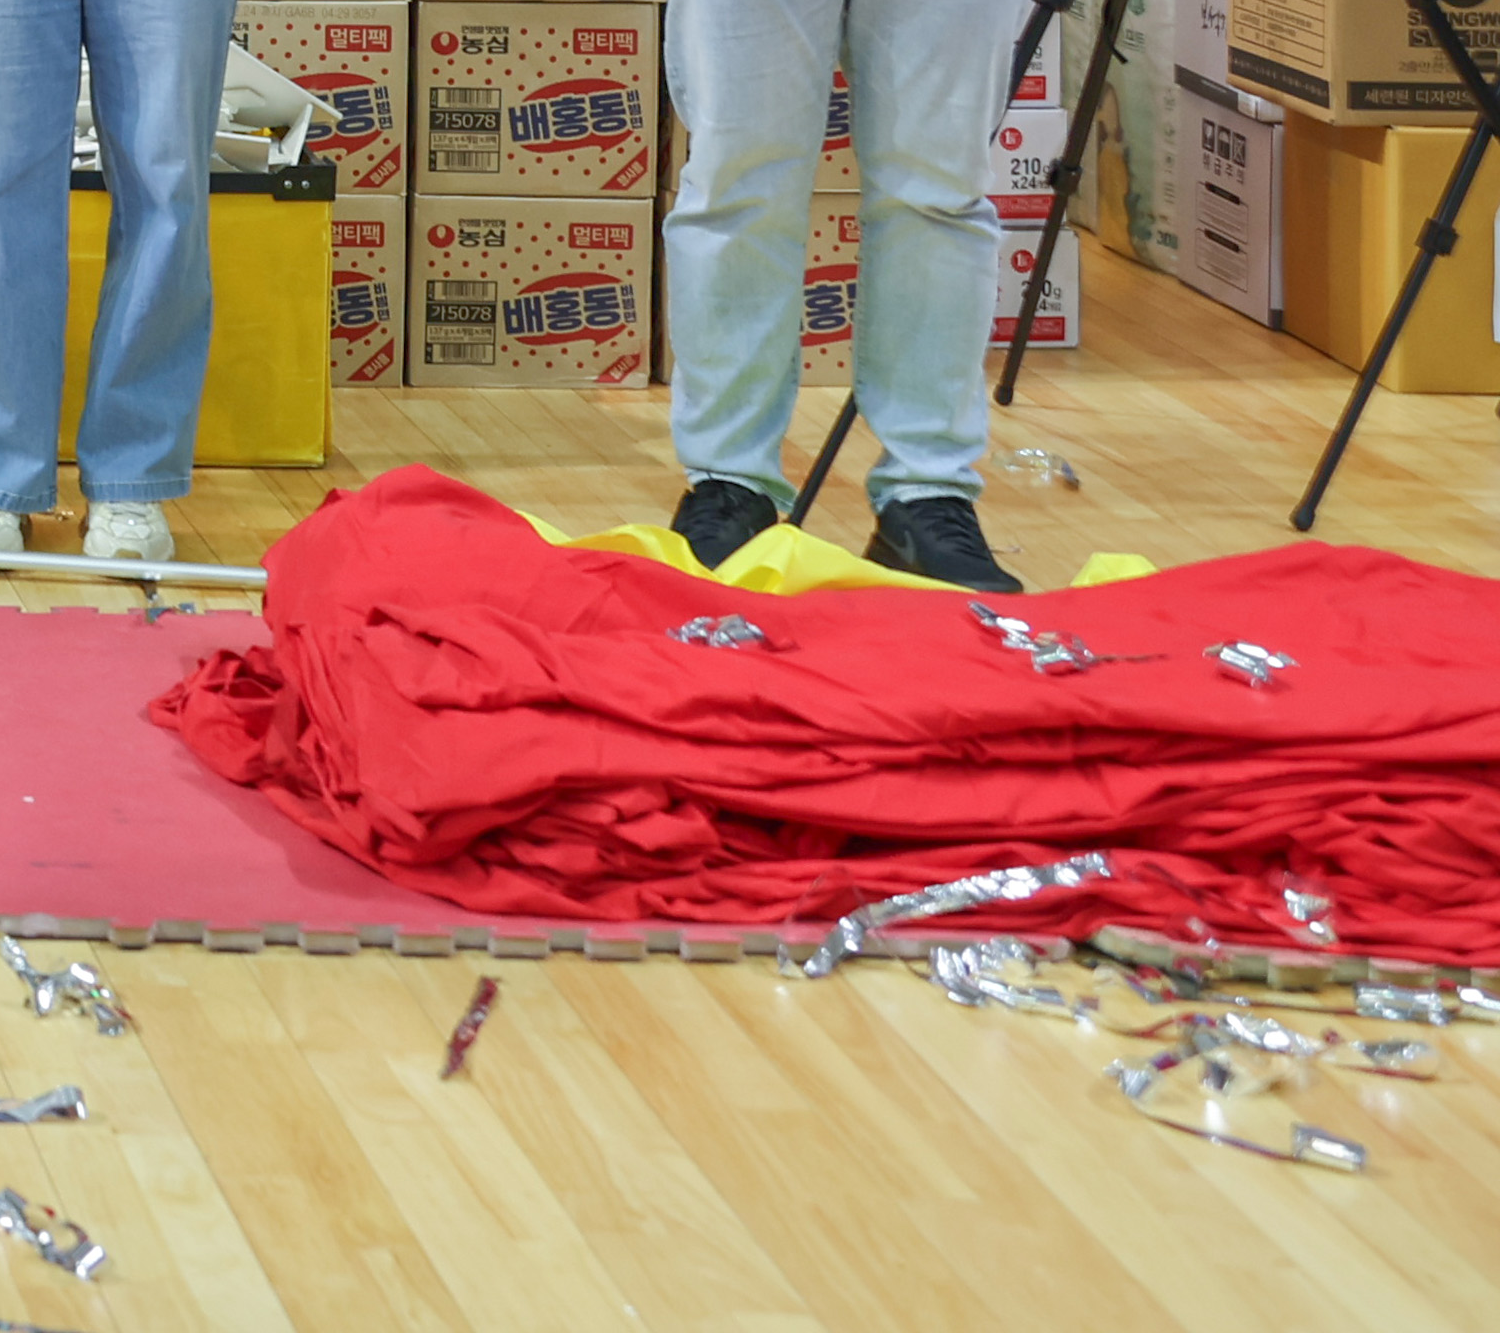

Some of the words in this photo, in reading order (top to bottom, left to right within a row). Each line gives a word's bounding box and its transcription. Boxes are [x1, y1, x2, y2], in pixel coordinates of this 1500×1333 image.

[329, 28, 388, 50] 멀티팩
[460, 35, 510, 55] 농심
[577, 31, 635, 53] 멀티팩
[434, 113, 496, 129] 가5078
[508, 92, 628, 143] 배홍동
[457, 228, 506, 248] 농심
[572, 226, 630, 247] 멀티팩
[430, 305, 493, 322] 가5078
[502, 285, 621, 335] 배홍동
